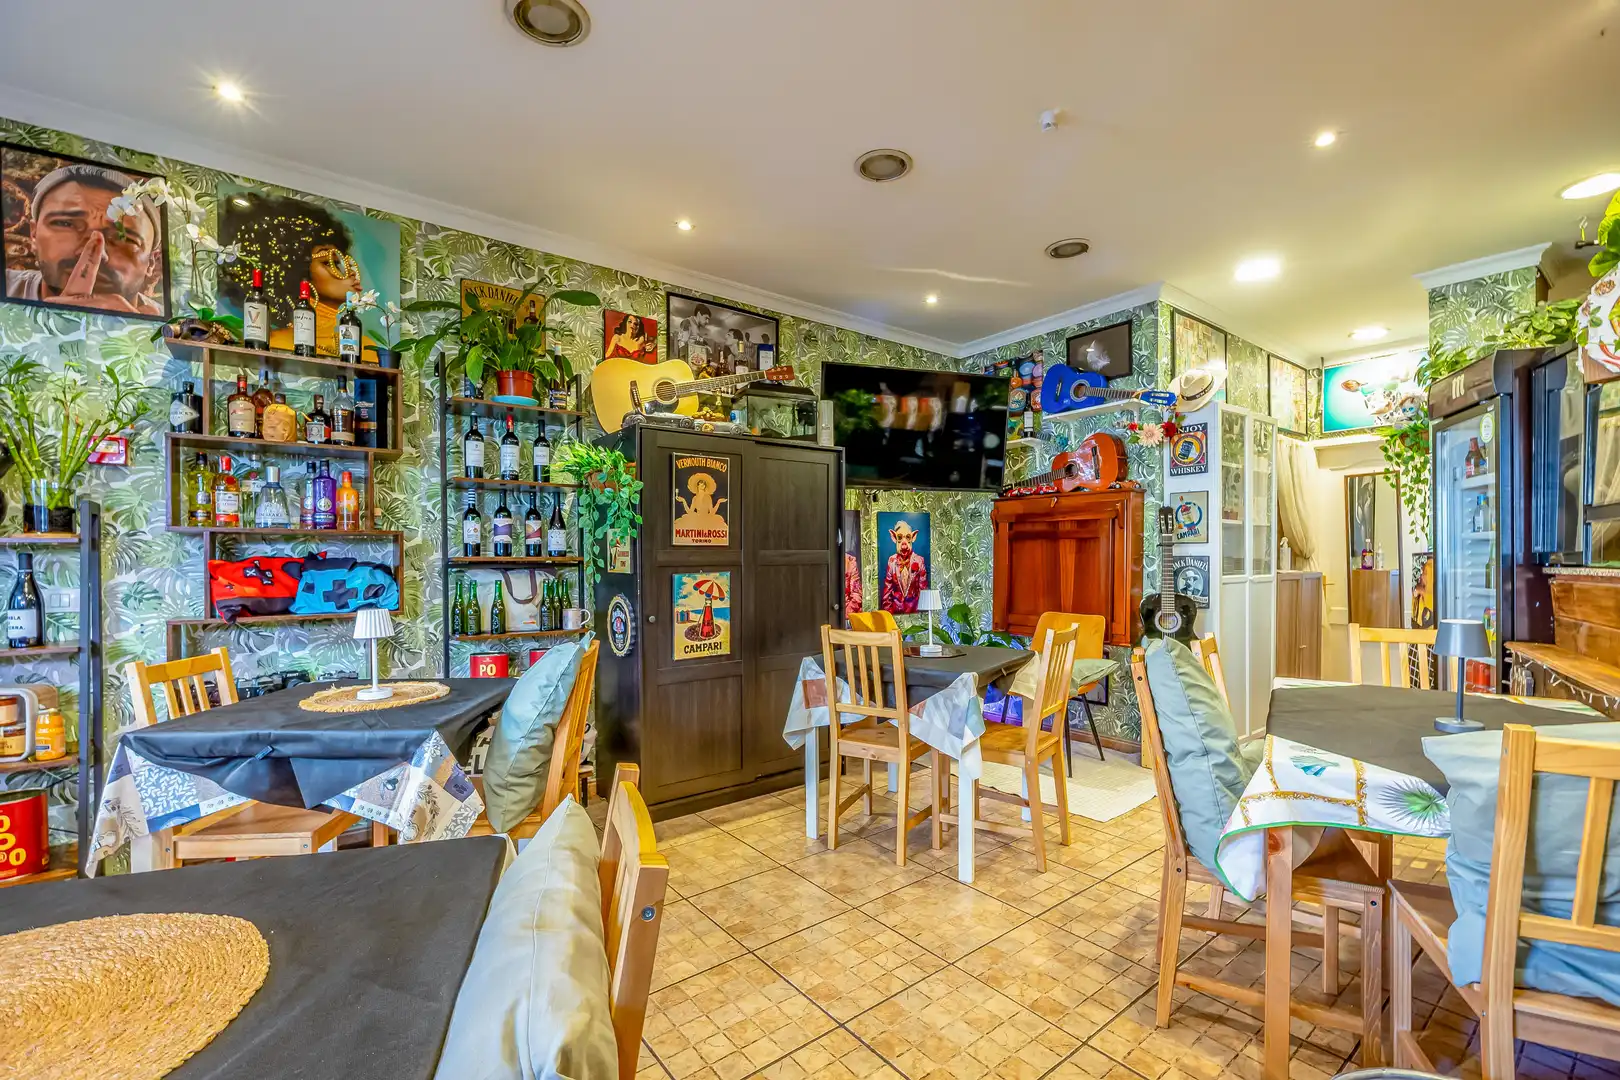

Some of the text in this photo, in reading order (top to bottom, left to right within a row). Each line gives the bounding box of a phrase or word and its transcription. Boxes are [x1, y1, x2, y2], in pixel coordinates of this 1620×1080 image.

[487, 287, 520, 305] DANIEL
[1177, 424, 1205, 433] NJOY
[676, 457, 728, 472] VERMOUTH BIANCO
[1170, 465, 1206, 475] WHISKEY
[1176, 528, 1200, 540] CAMPARI
[1173, 557, 1208, 571] JACK DANIEL'S
[684, 642, 722, 654] CAMPARI
[479, 663, 497, 677] PO
